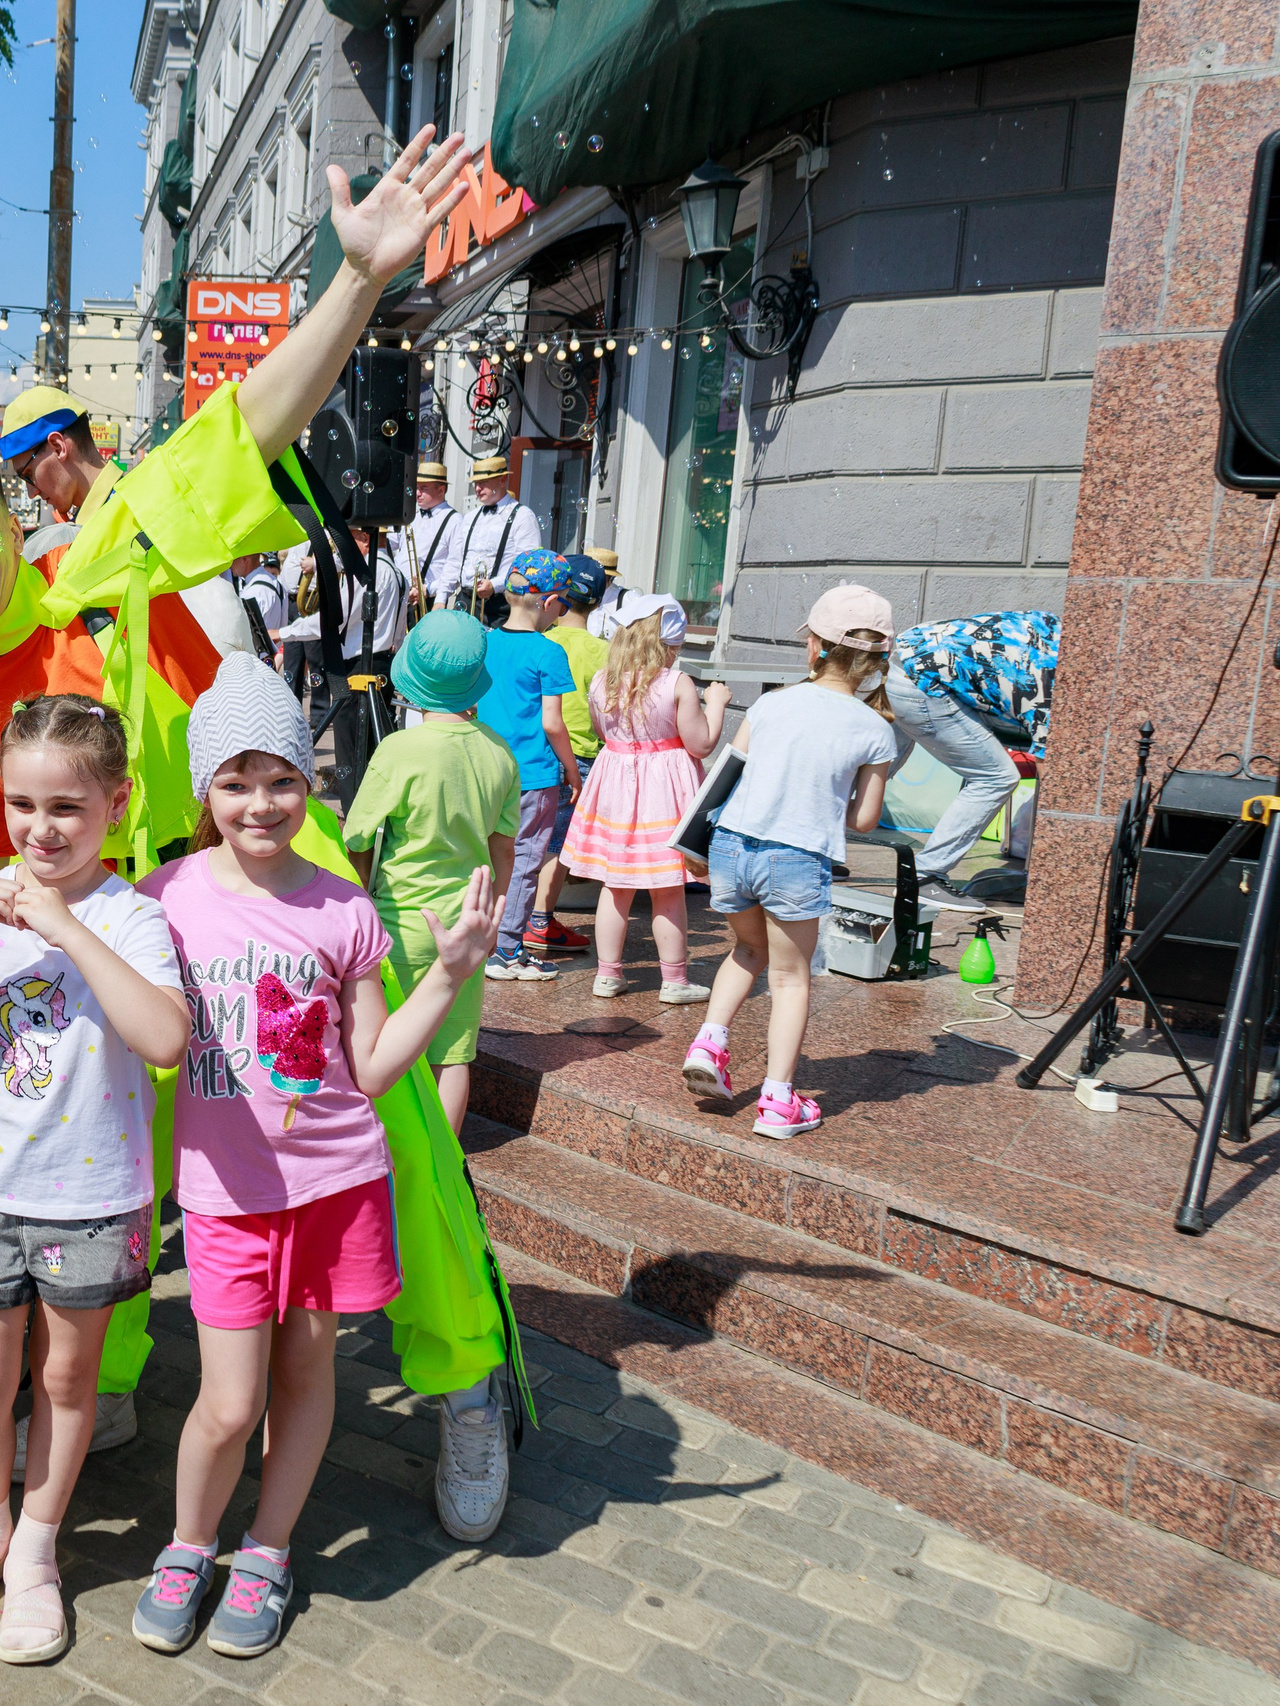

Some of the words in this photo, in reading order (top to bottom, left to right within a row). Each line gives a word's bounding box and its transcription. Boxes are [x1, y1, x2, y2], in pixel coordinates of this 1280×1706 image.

[197, 290, 282, 317] DNS
[199, 350, 268, 361] www.dns-shop
[186, 1047, 255, 1100] MER
[86, 1223, 105, 1240] are
